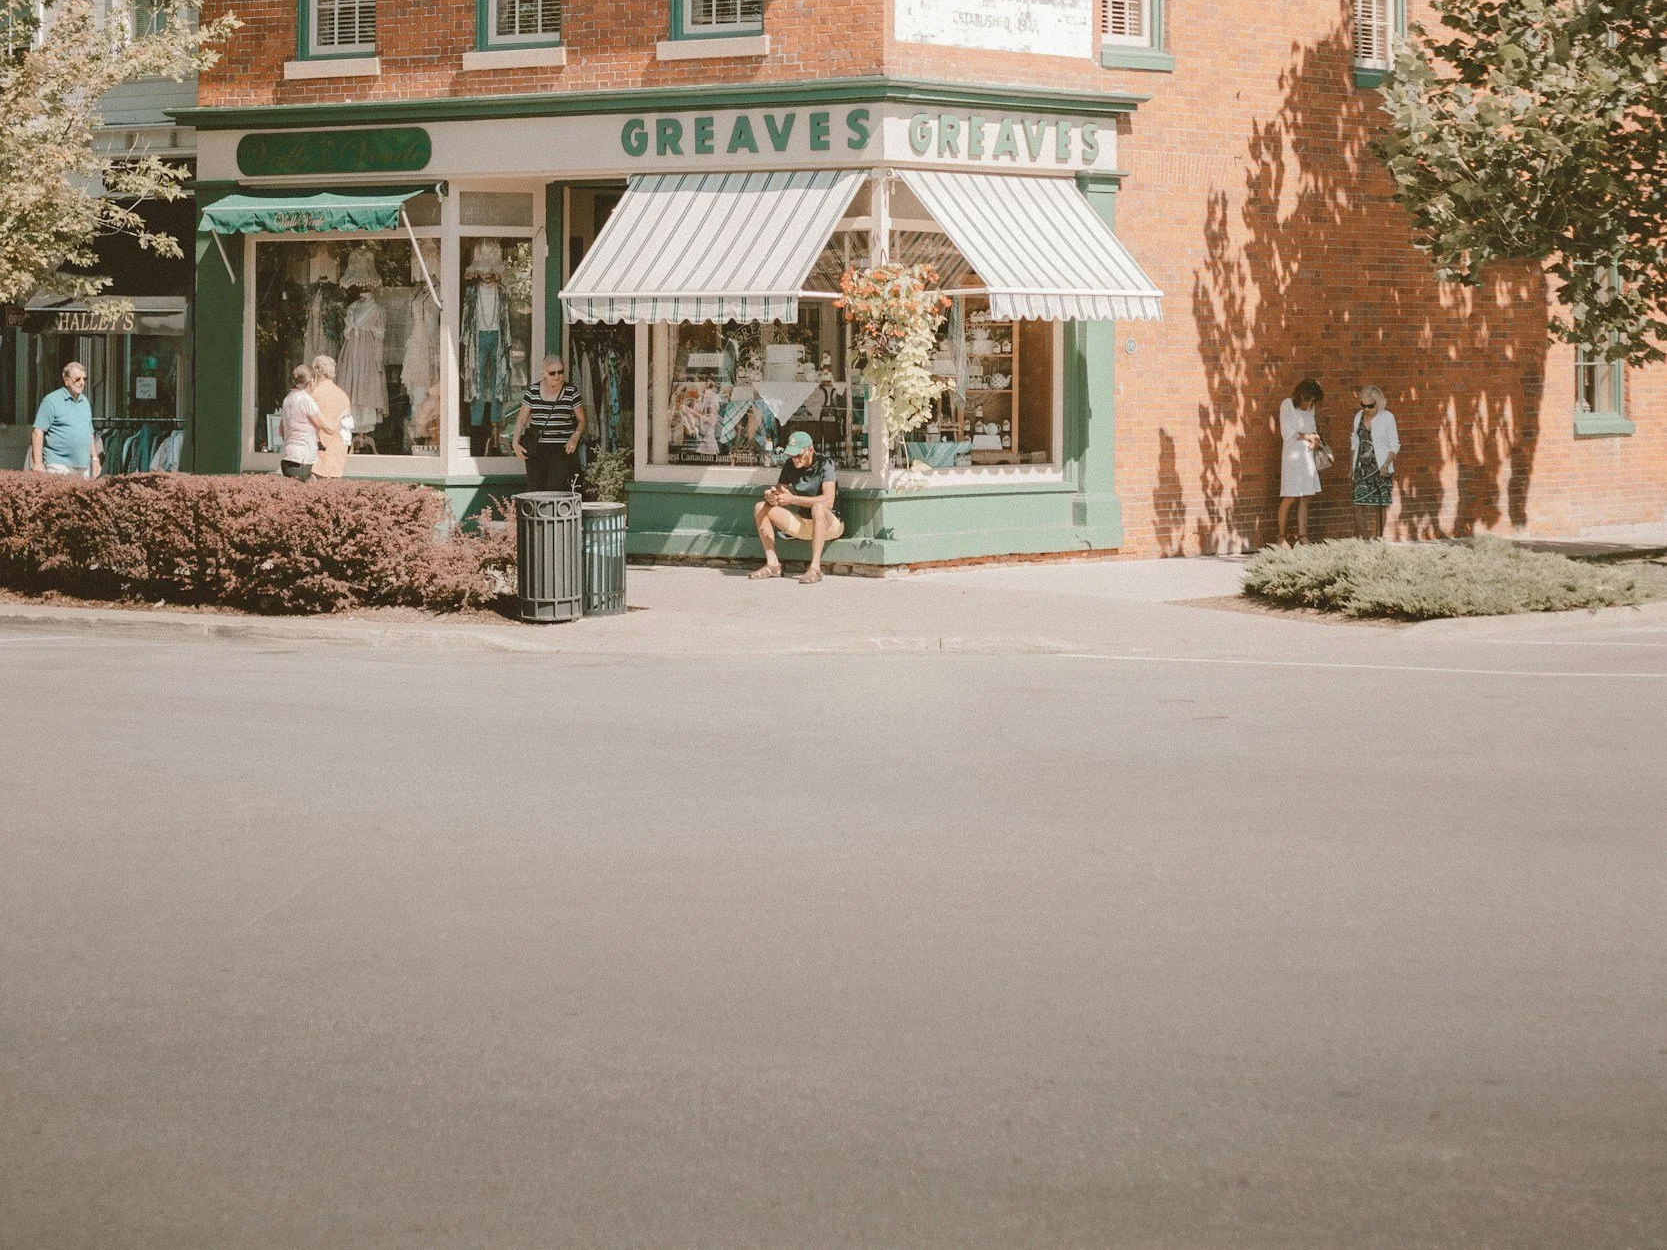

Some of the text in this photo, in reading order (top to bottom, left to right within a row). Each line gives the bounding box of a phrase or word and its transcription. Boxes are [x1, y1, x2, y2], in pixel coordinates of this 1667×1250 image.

[1016, 16, 1040, 33] 19
[621, 108, 871, 157] GREAVES
[909, 112, 1100, 166] GREAVES
[8, 314, 24, 325] OPE
[680, 451, 715, 462] Canadian
